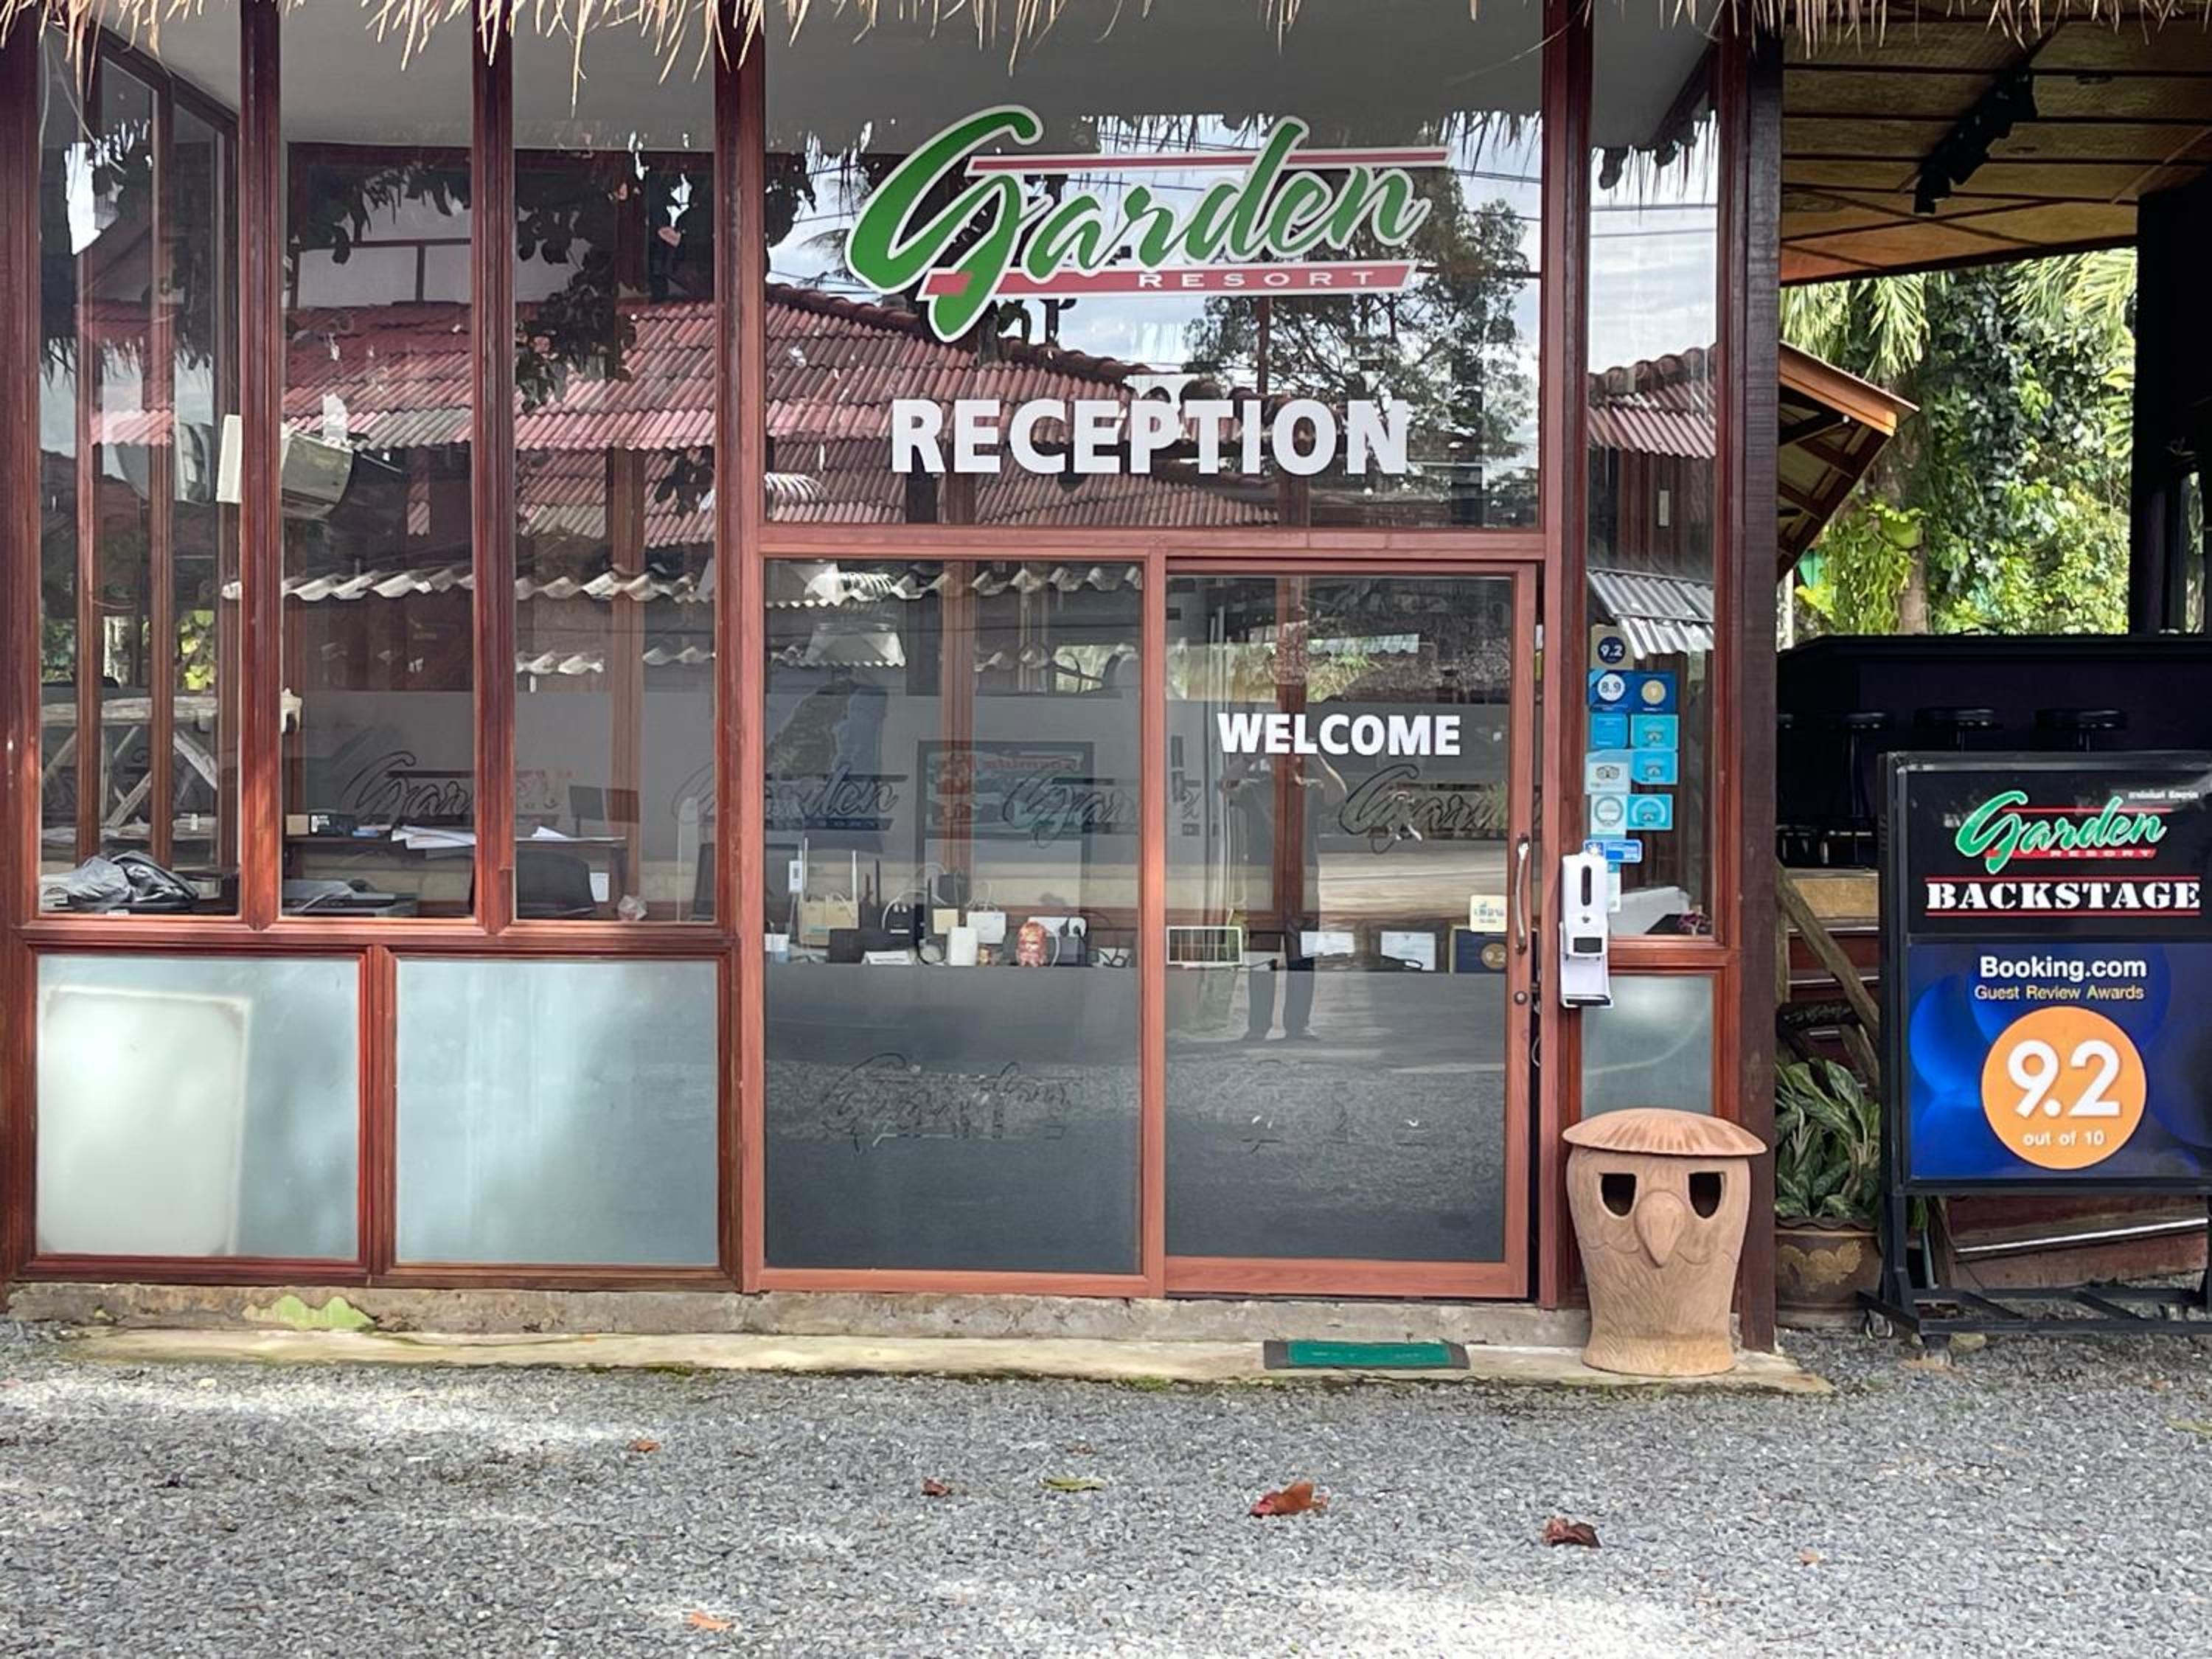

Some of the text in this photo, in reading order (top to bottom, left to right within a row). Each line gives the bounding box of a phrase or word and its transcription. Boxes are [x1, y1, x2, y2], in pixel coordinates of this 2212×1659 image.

[844, 104, 1433, 344] Garden
[1138, 270, 1374, 289] RESORT
[891, 397, 1408, 476] RECEPTION
[1599, 644, 1624, 658] 9.2
[1600, 681, 1622, 694] 8.9
[1216, 712, 1461, 757] WELCOME
[1955, 790, 2167, 874] Garden
[1926, 883, 2201, 909] BACKSTAGE
[1979, 956, 2147, 982] Booking.com
[1974, 985, 2145, 1000] Guest Review Awards
[2006, 1038, 2121, 1119] 9.2
[2023, 1130, 2105, 1146] out of 10
